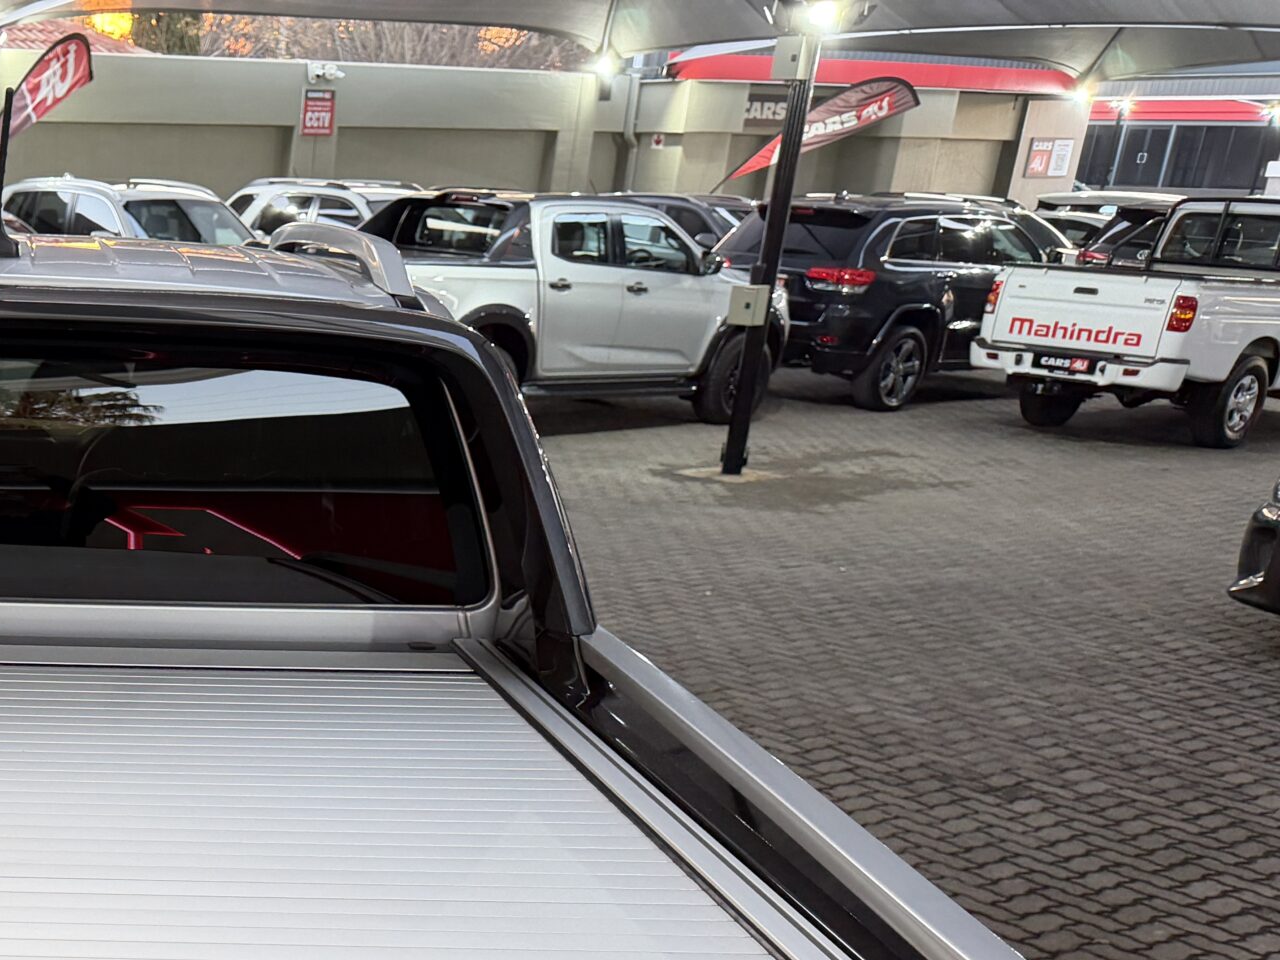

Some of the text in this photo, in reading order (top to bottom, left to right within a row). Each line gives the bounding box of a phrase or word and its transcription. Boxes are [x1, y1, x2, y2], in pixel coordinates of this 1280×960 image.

[305, 111, 332, 128] CCTV
[1008, 316, 1143, 347] Mahindra
[1039, 355, 1072, 369] CARS
